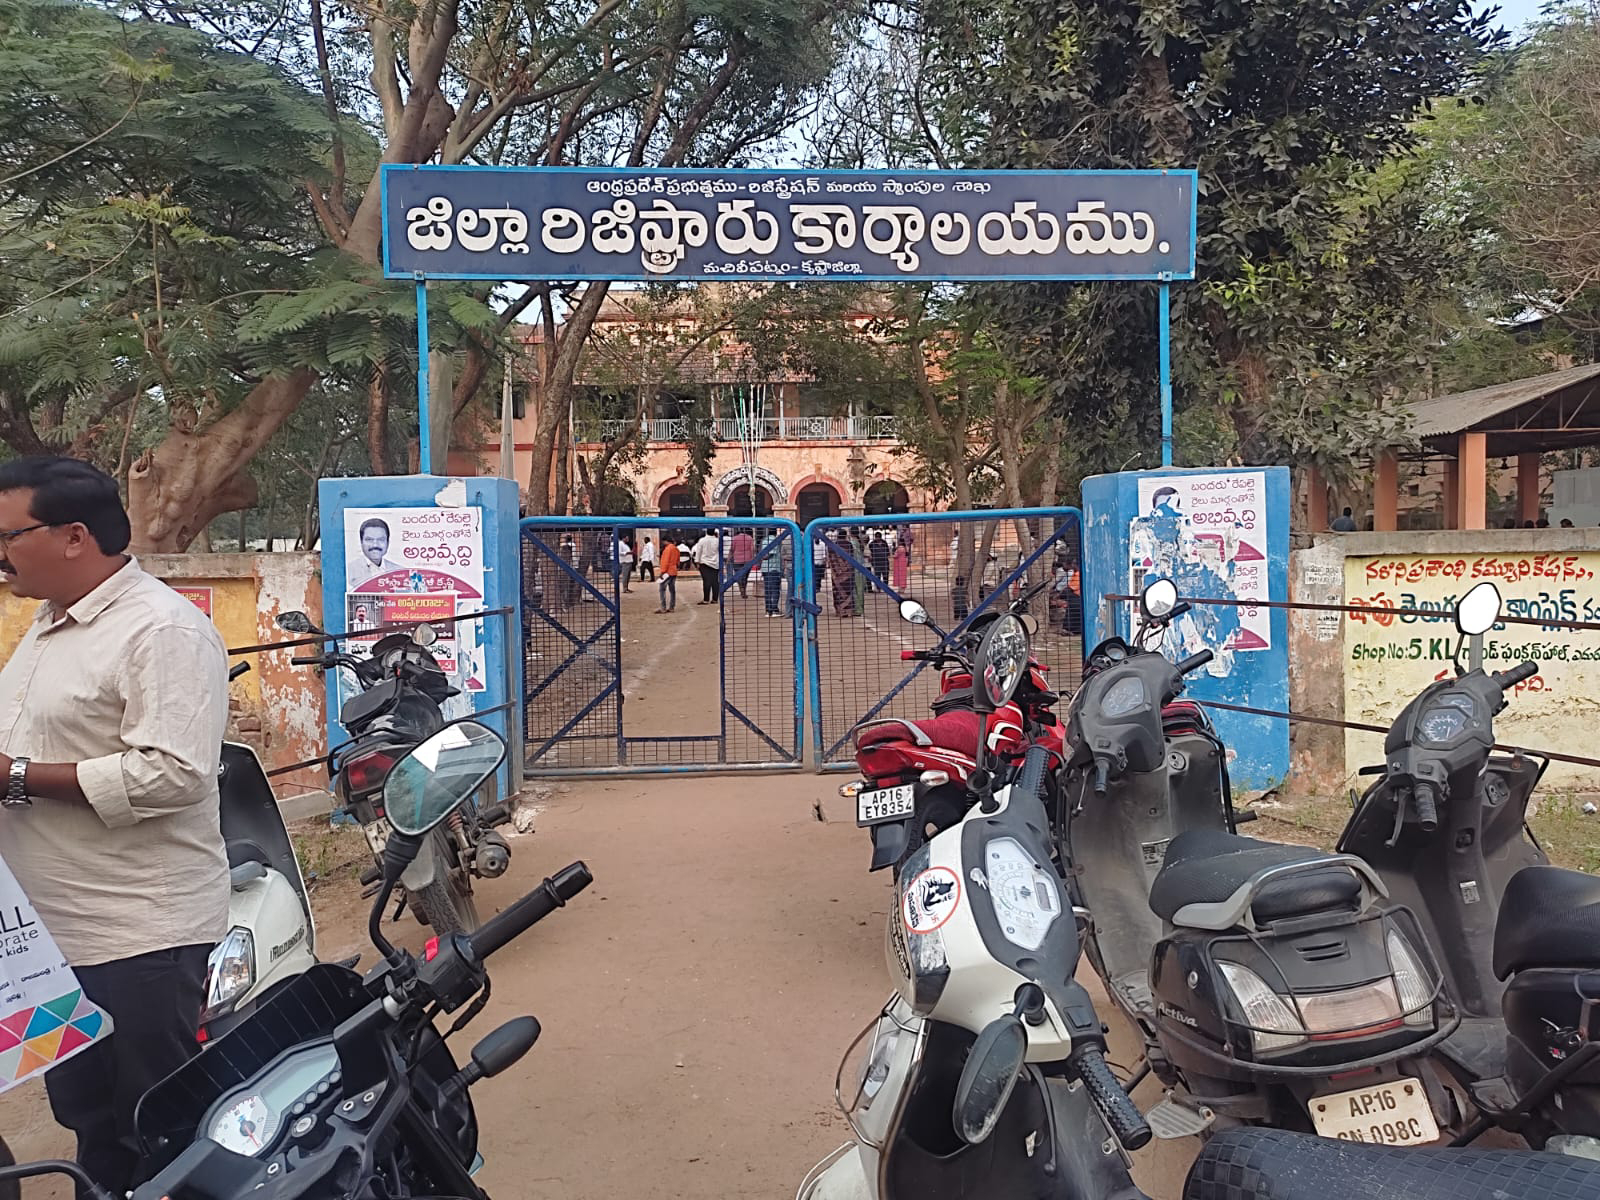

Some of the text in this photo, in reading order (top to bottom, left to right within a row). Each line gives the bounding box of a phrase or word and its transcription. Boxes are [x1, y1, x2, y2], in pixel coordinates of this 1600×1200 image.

[826, 181, 877, 194] మరియు
[952, 180, 992, 195] శాఖ
[405, 196, 530, 254] జిల్లా
[1352, 643, 1386, 663] Shop
[872, 788, 903, 805] AP16
[0, 905, 36, 936] LL
[6, 945, 30, 958] kids
[1156, 1001, 1199, 1027] Activa
